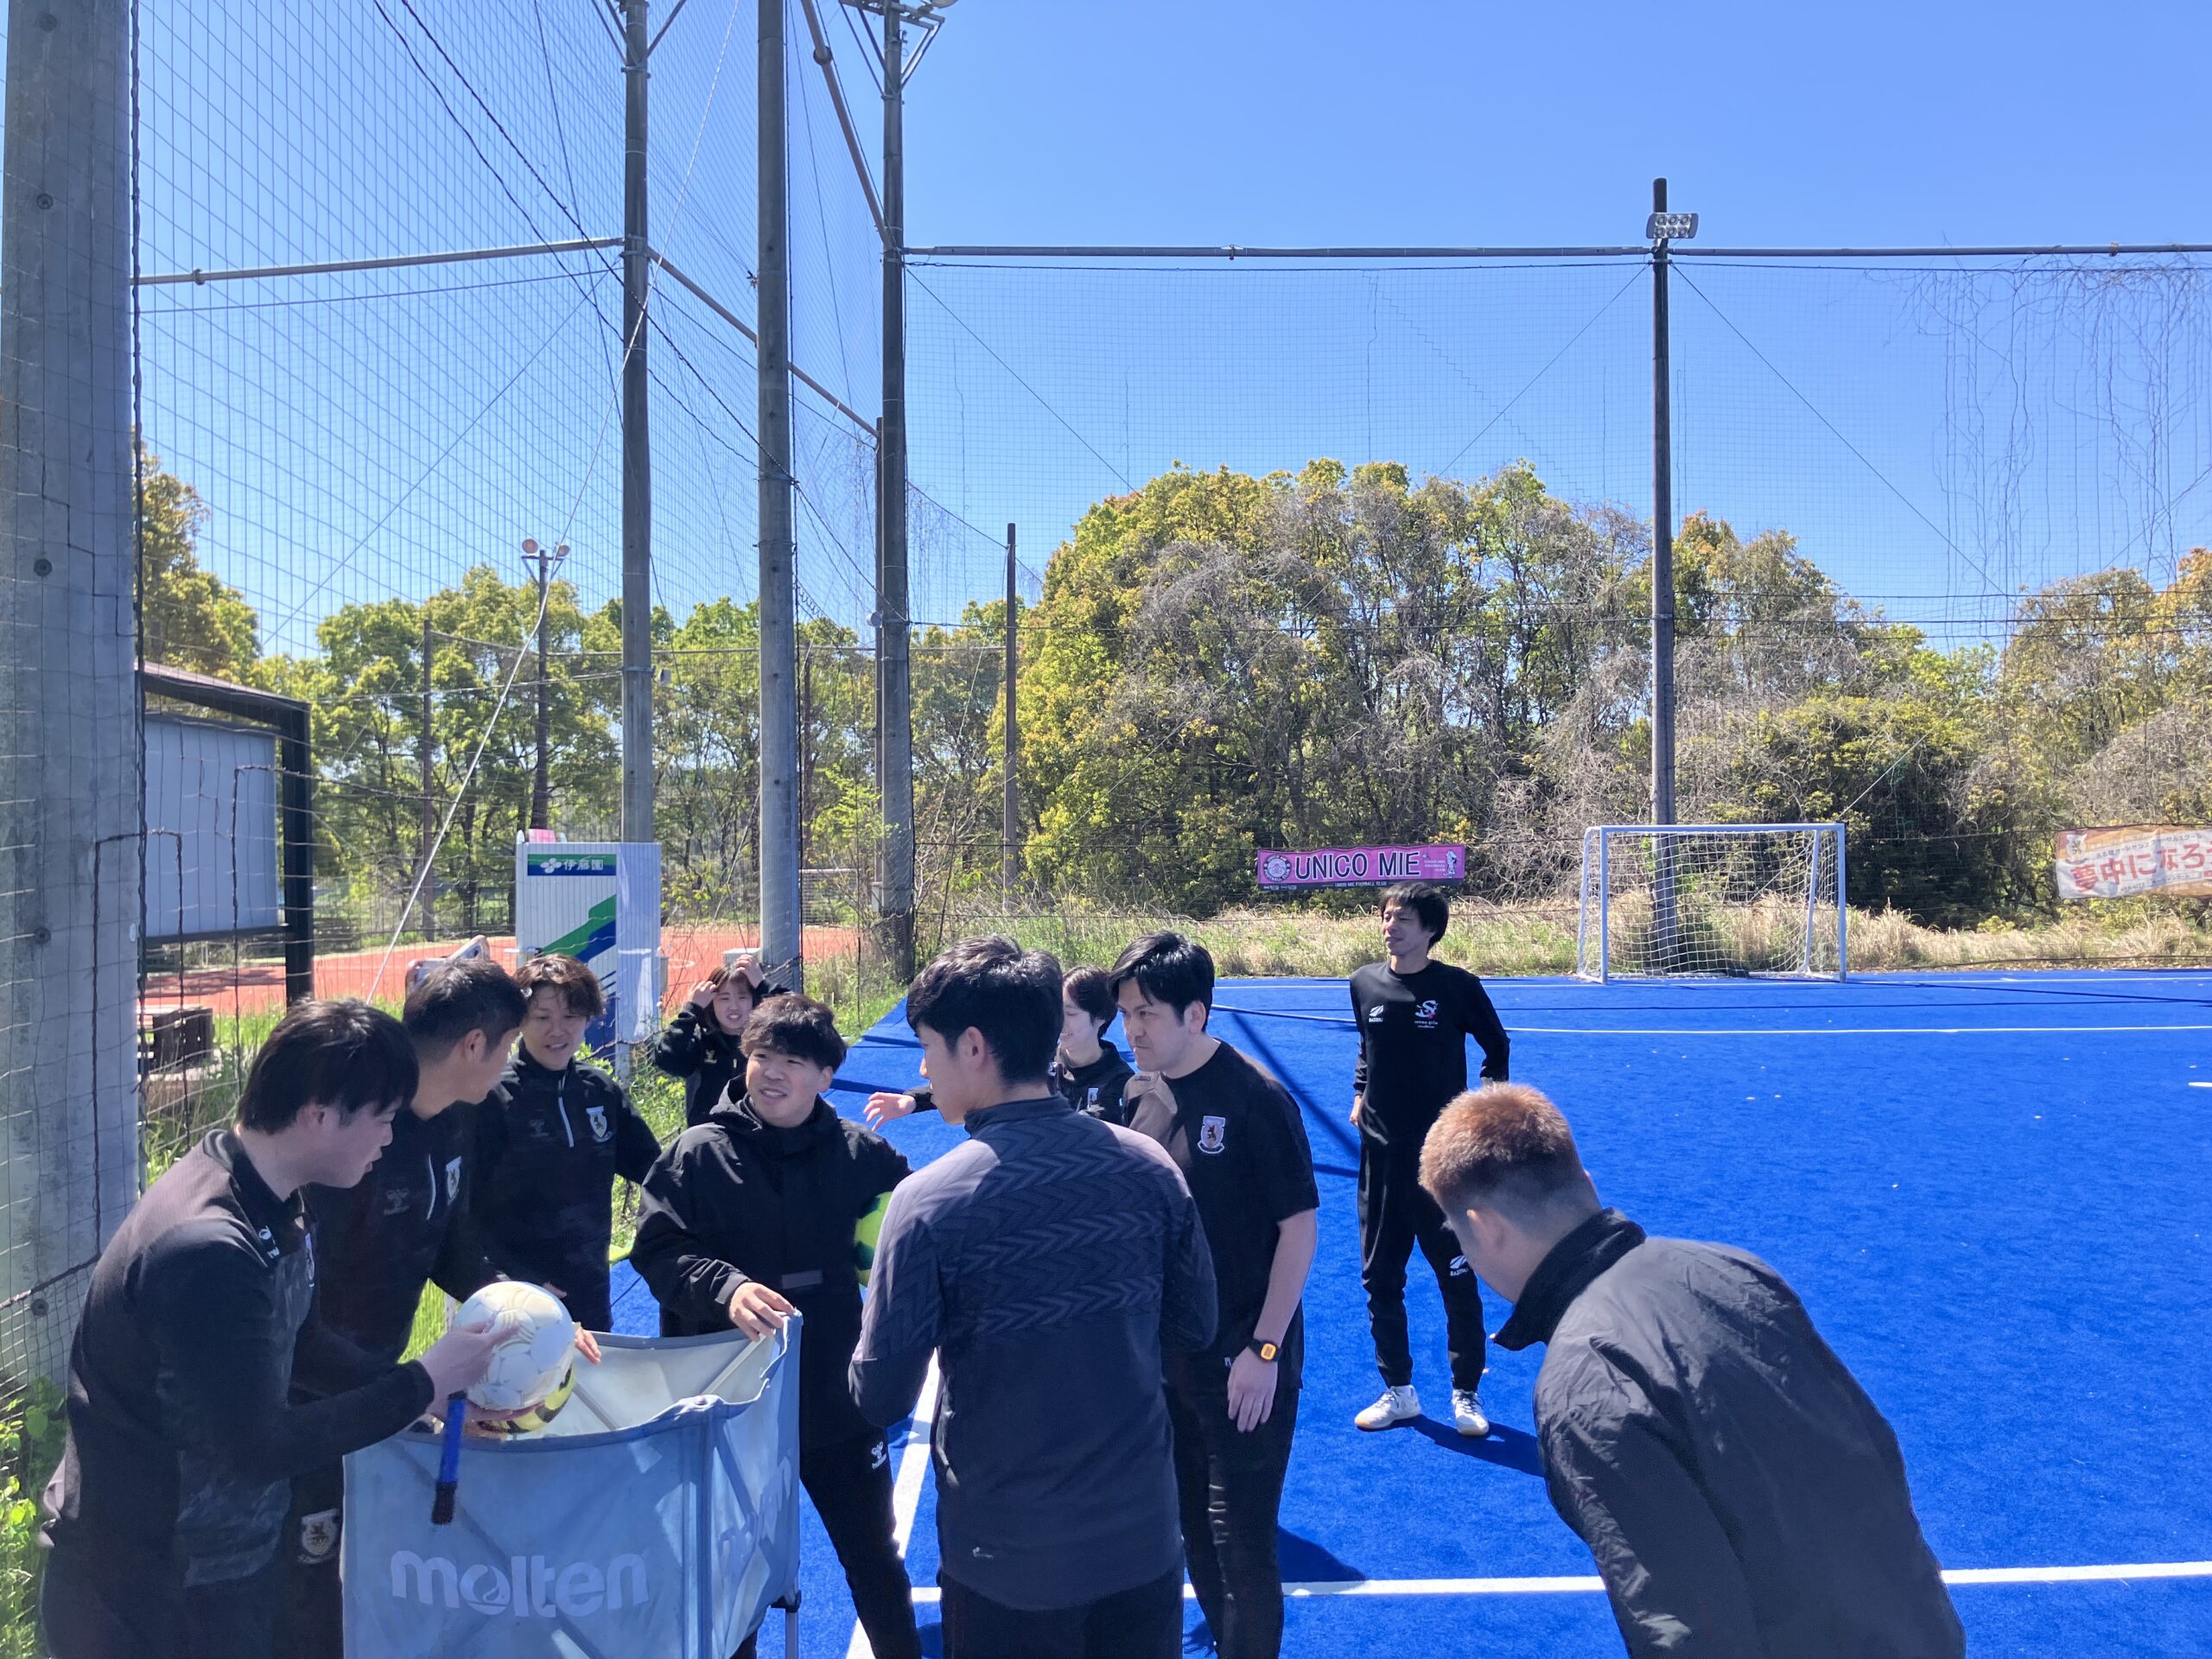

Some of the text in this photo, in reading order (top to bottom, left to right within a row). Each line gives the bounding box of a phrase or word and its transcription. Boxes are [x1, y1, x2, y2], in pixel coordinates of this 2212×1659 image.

[563, 858, 604, 871] 伊藤園
[1296, 852, 1368, 880] UNICO
[1378, 850, 1421, 877] MIE
[391, 1550, 649, 1618] molten
